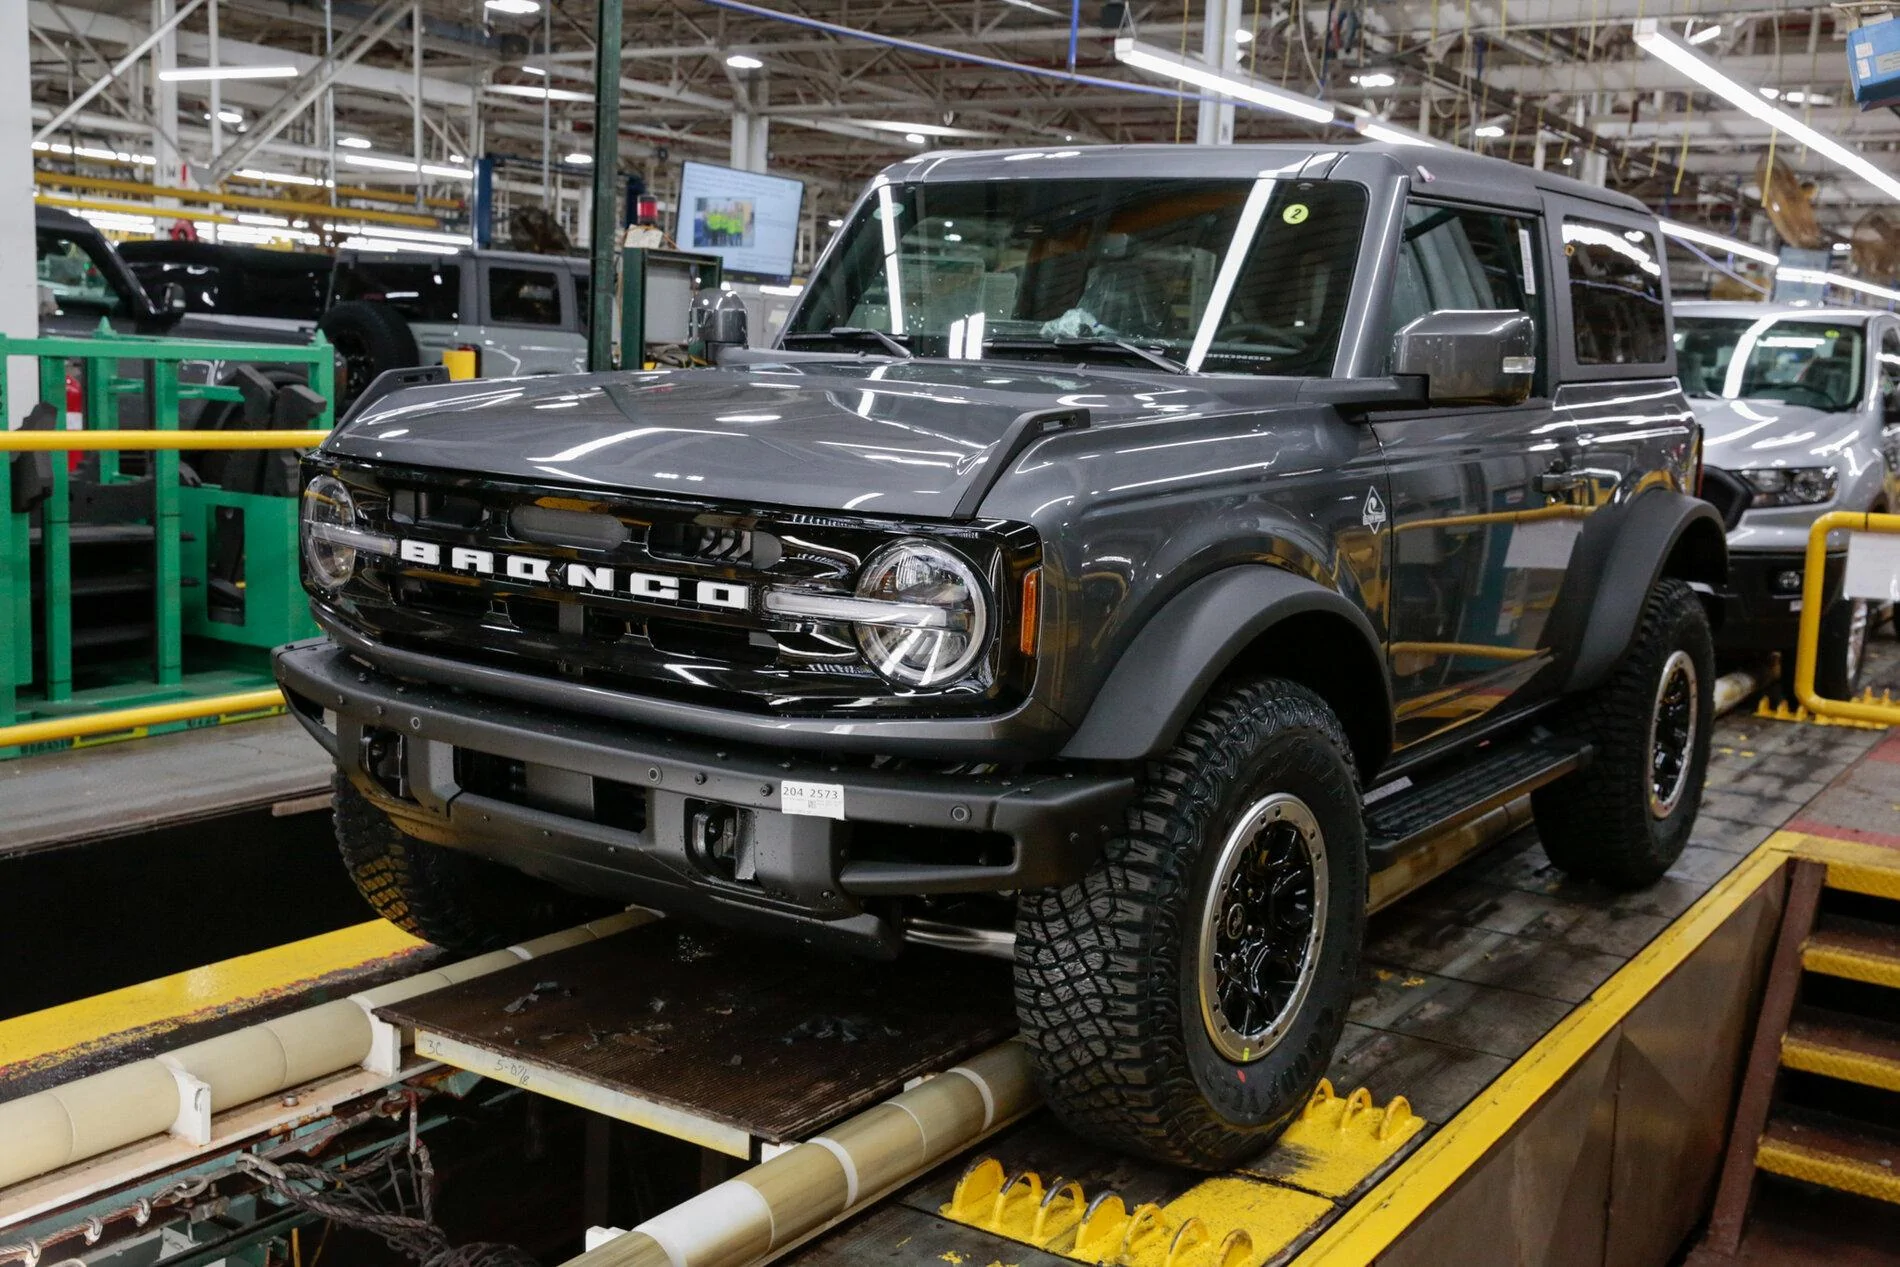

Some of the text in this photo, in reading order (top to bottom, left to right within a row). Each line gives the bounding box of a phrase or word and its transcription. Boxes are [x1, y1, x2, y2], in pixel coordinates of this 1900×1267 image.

[1290, 208, 1302, 220] 2
[400, 539, 748, 609] BRONCO
[783, 786, 838, 800] 204 2573
